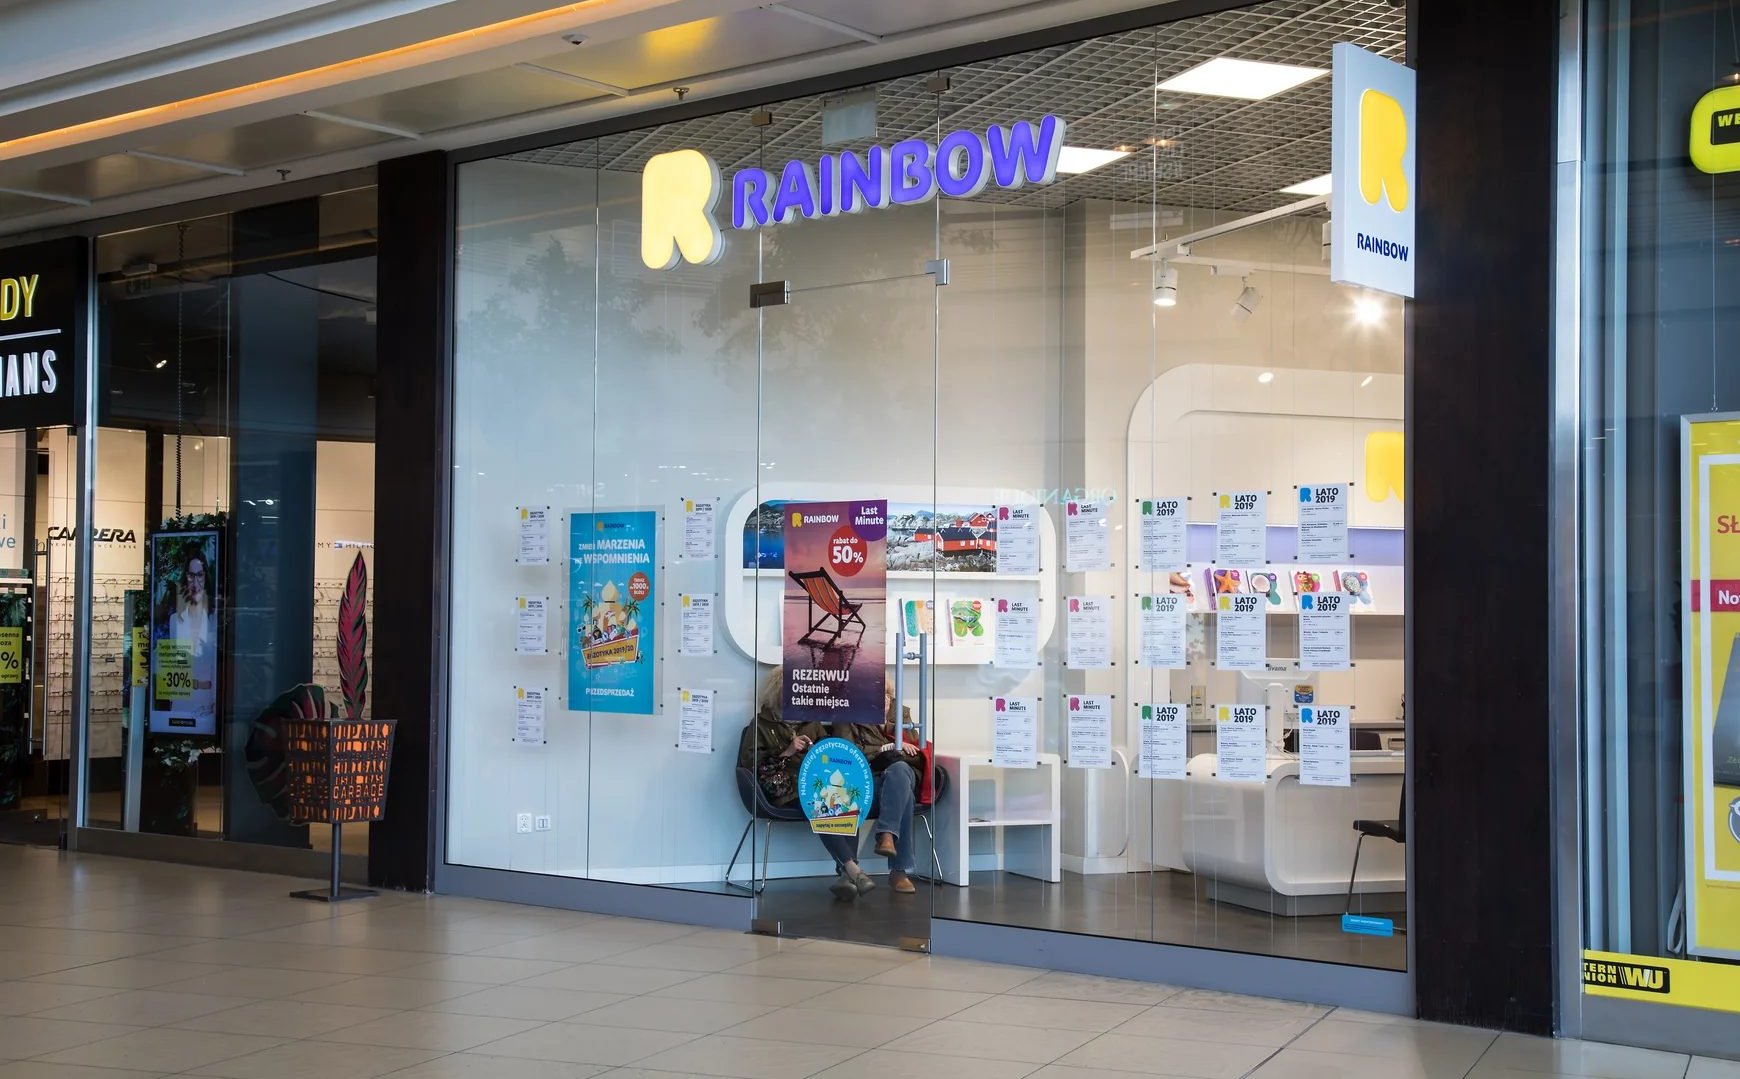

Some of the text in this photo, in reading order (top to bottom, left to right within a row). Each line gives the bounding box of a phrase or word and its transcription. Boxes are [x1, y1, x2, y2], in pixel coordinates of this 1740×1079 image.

[1359, 88, 1408, 213] R
[641, 149, 722, 271] R
[733, 115, 1066, 230] RAINBOW
[1357, 232, 1409, 262] RAINBOW
[1, 274, 39, 320] DY
[1316, 487, 1339, 496] LATO
[1235, 494, 1257, 503] LATO
[1316, 495, 1336, 504] 2019
[1156, 501, 1178, 509] LATO
[1234, 502, 1254, 510] 2019
[861, 506, 878, 515] Last
[1156, 508, 1175, 516] 2019
[804, 514, 839, 524] RAINBOW
[855, 516, 884, 526] Minute
[47, 526, 136, 543] CAERA
[597, 538, 646, 550] MARZENIA
[583, 552, 650, 564] WSPOMNIENIA
[832, 546, 863, 564] 50%
[1156, 597, 1178, 605] LATO
[1235, 596, 1257, 605] LATO
[1317, 596, 1341, 604] LATO
[1718, 590, 1740, 605] No
[1156, 604, 1175, 612] 2019
[1234, 604, 1254, 612] 2019
[1317, 603, 1338, 612] 2019
[163, 672, 191, 688] -30%
[792, 669, 849, 682] REZERWUJ
[792, 683, 830, 694] Ostatnie
[791, 695, 849, 708] takie miejsca
[1234, 707, 1257, 716] LATO
[1317, 710, 1340, 718] LATO
[1156, 714, 1175, 722] 2019
[1234, 715, 1254, 723] 2019
[1317, 718, 1337, 726] 2019
[801, 741, 871, 805] Najbardziej egzotyczna oferta na rynku
[1624, 966, 1663, 989] WU
